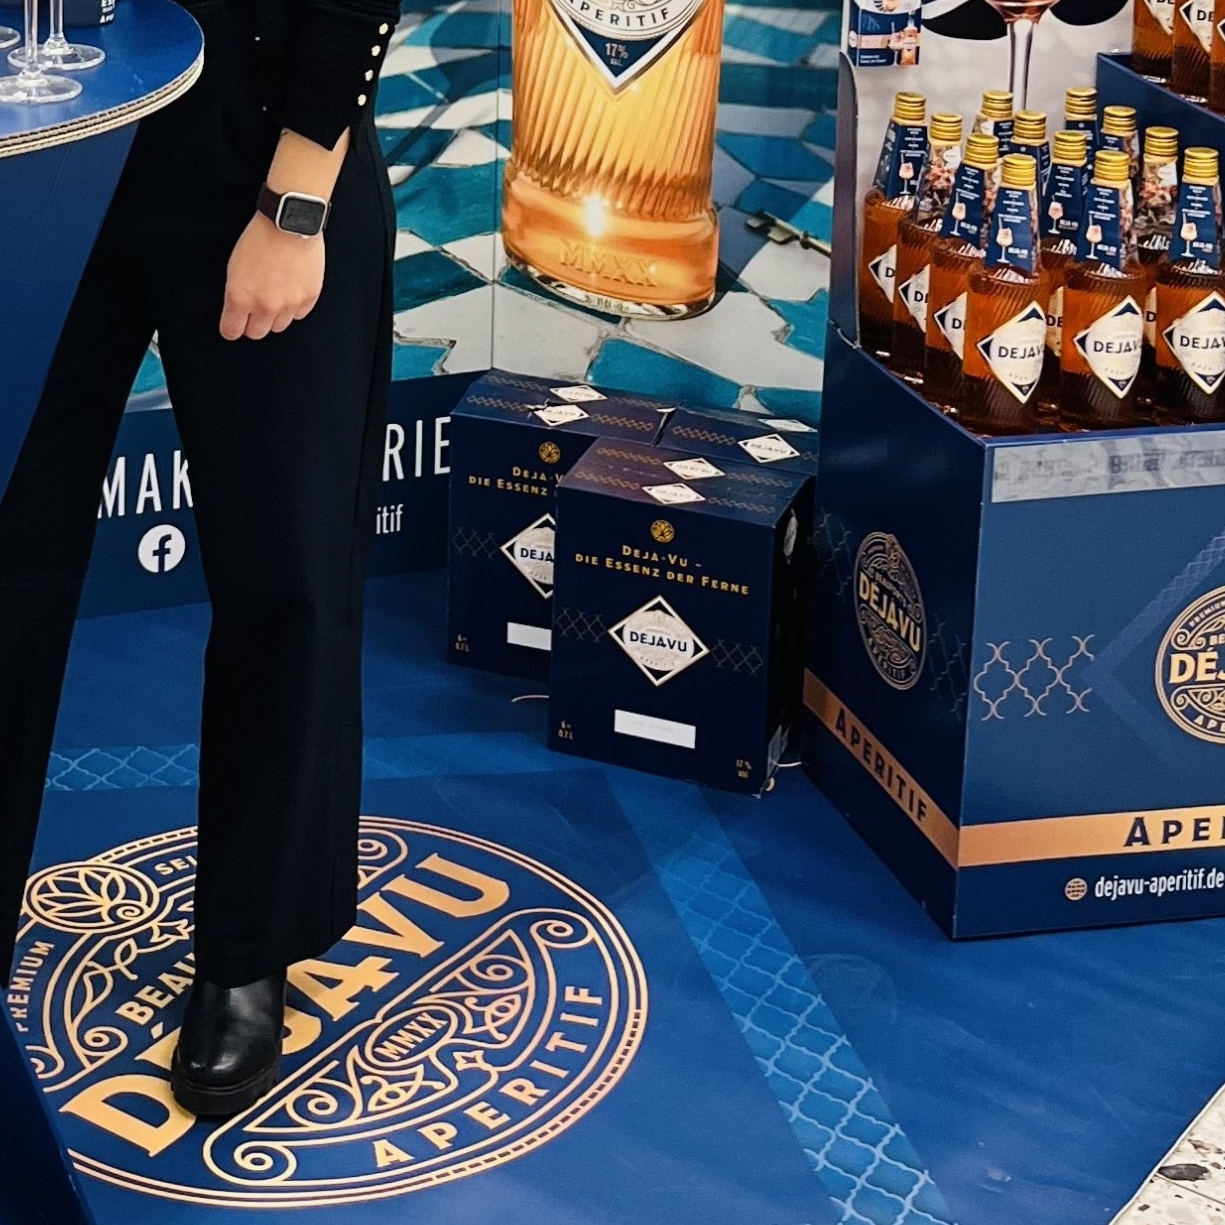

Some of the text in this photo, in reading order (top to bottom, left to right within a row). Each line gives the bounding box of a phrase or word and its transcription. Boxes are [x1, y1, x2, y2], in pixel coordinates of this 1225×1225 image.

[605, 42, 629, 60] 17%
[468, 475, 548, 496] DIE ESSENZ
[575, 553, 749, 595] DIE ESSENZ DER FERNE
[1169, 647, 1225, 684] DÉ
[833, 705, 928, 824] APERITIF
[1123, 815, 1225, 850] APE
[1095, 868, 1225, 901] dejavu-aperitif.de
[372, 1010, 451, 1064] MMXX
[375, 985, 604, 1170] APERITIF
